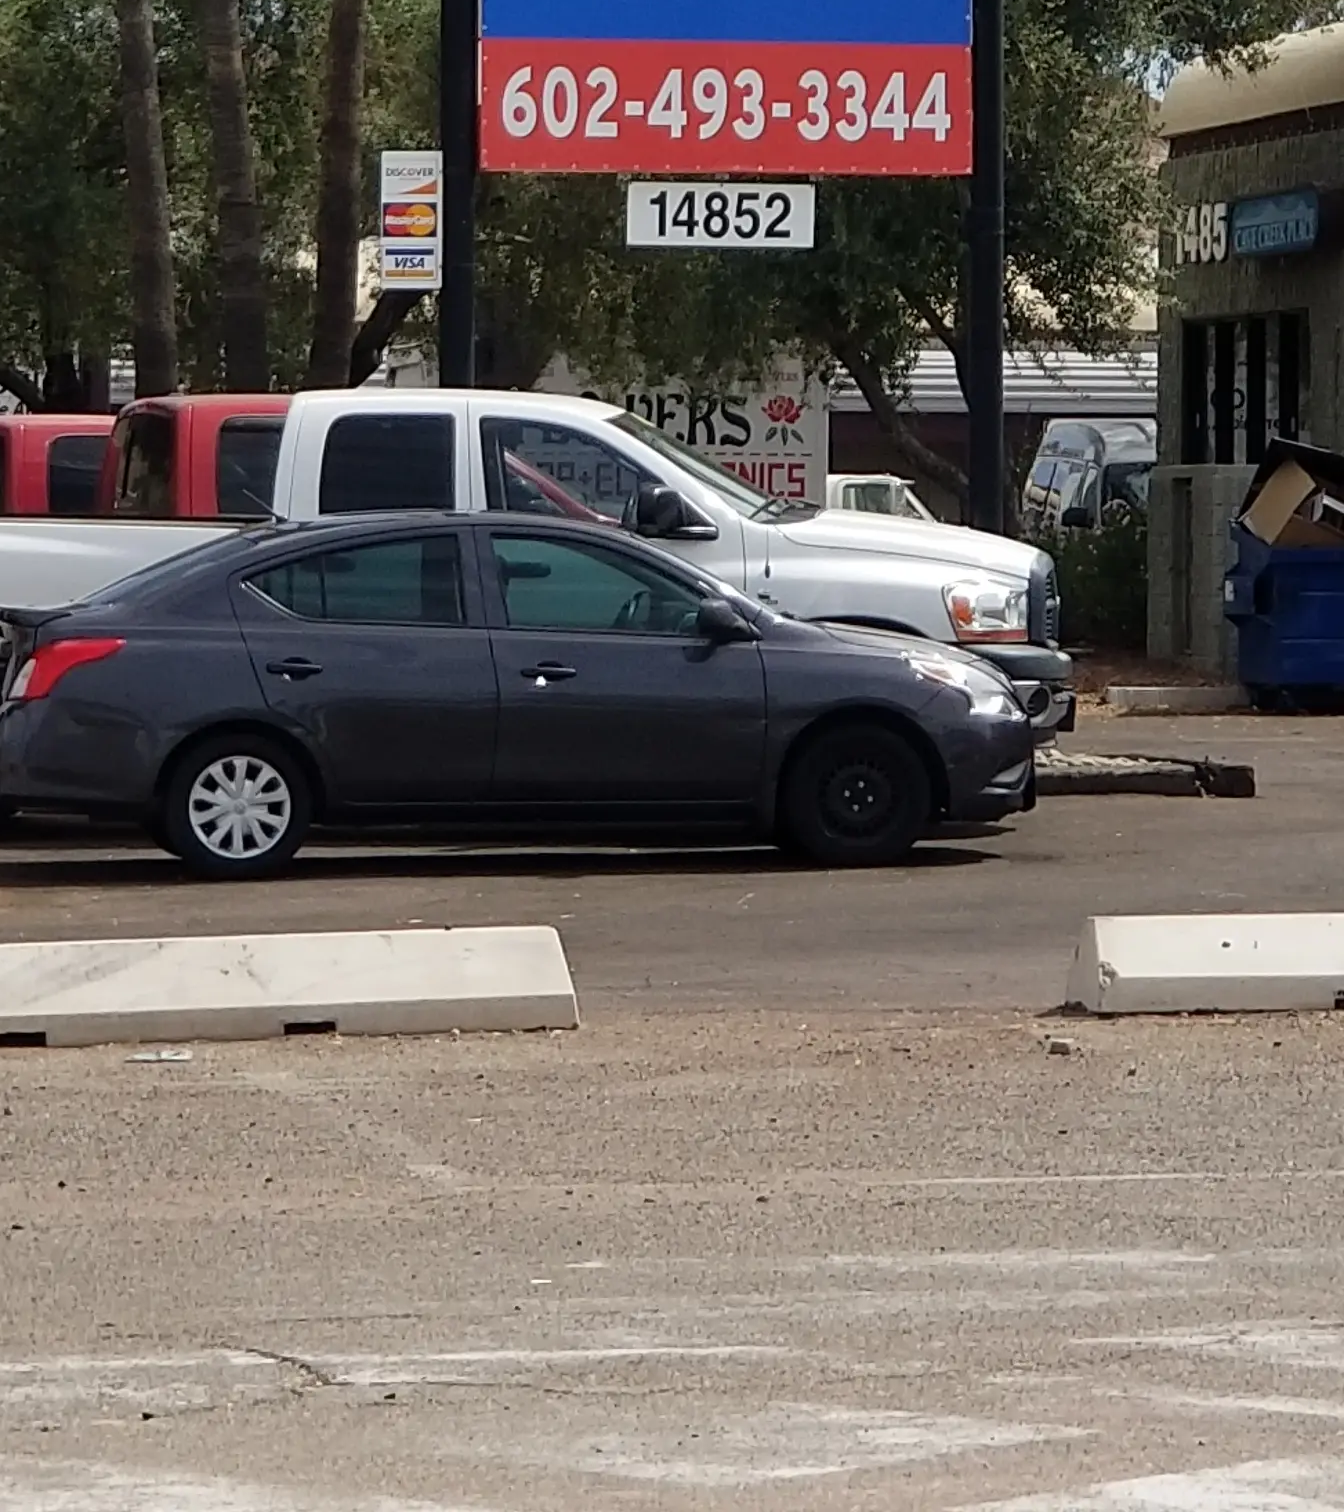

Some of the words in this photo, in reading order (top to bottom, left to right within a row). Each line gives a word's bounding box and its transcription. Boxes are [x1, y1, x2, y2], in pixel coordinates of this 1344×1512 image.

[501, 65, 952, 142] 602-493-3344
[385, 167, 434, 177] DISCOVER
[649, 190, 792, 239] 14852
[394, 257, 425, 269] VISA
